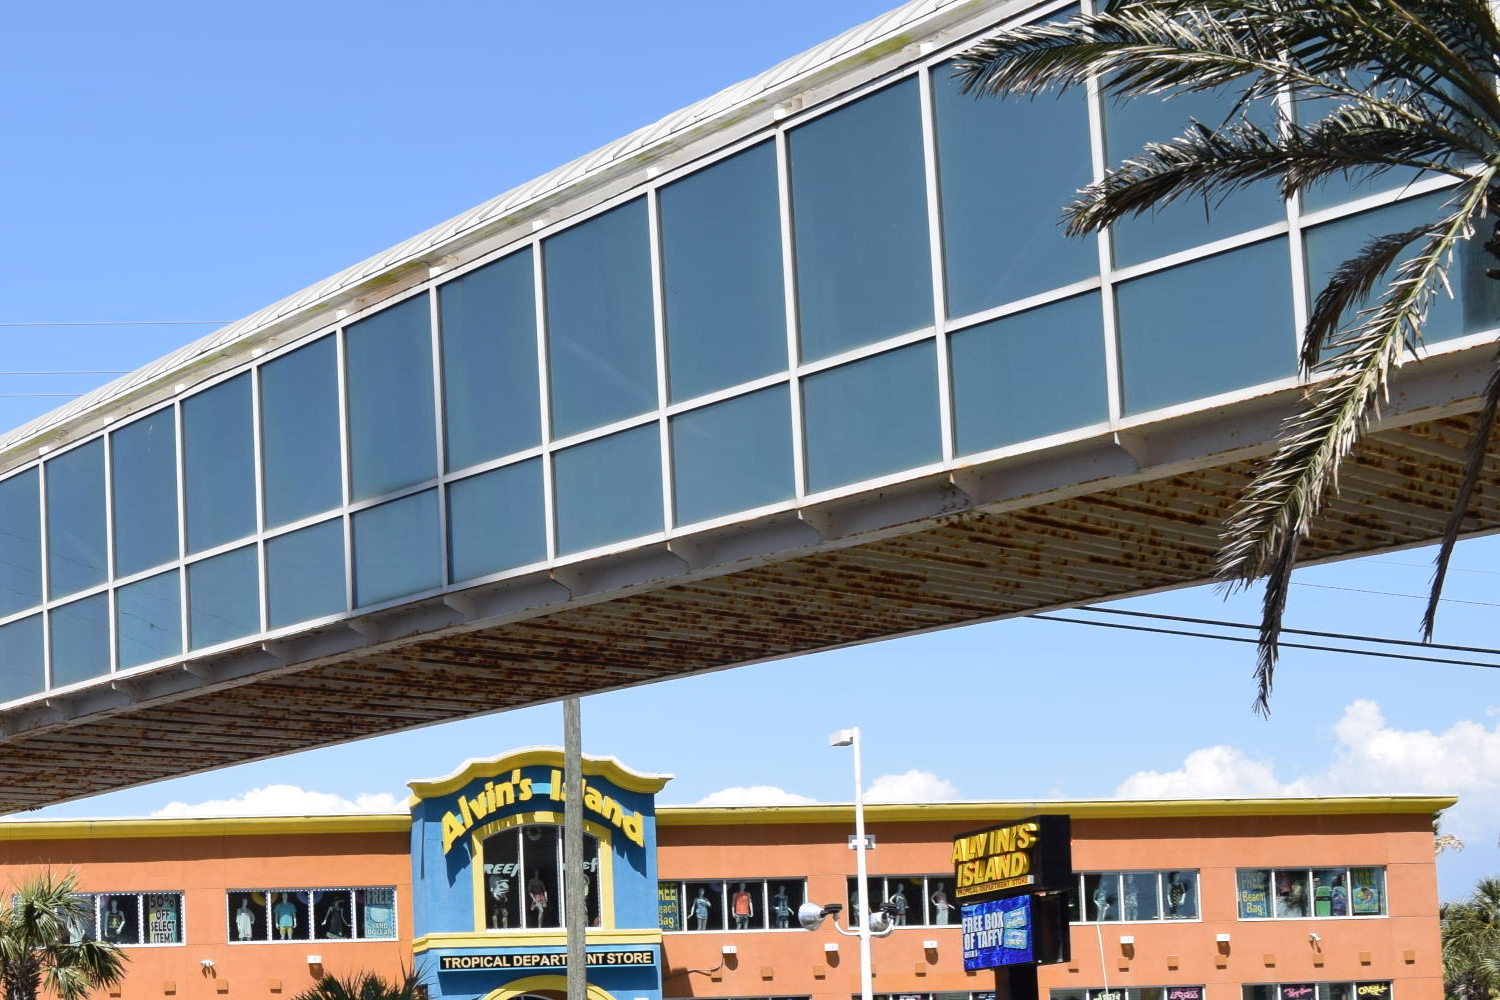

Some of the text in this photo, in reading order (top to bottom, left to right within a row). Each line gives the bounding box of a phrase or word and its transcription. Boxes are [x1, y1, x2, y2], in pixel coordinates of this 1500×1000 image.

[442, 769, 532, 855] Alvin's
[952, 823, 1040, 864] ALVIN'S
[957, 851, 1030, 888] ISLAND
[150, 894, 175, 908] 50%
[366, 889, 391, 905] FREE
[156, 909, 170, 920] OFF
[1246, 902, 1263, 915] Bag
[150, 920, 176, 932] SELECT
[962, 915, 983, 934] FREE
[984, 911, 1004, 931] BOX
[153, 932, 174, 944] ITEMS
[964, 932, 976, 951] OF
[977, 928, 1003, 949] TAFFY
[443, 952, 652, 969] TROPICAL DEPARTNT STORE
